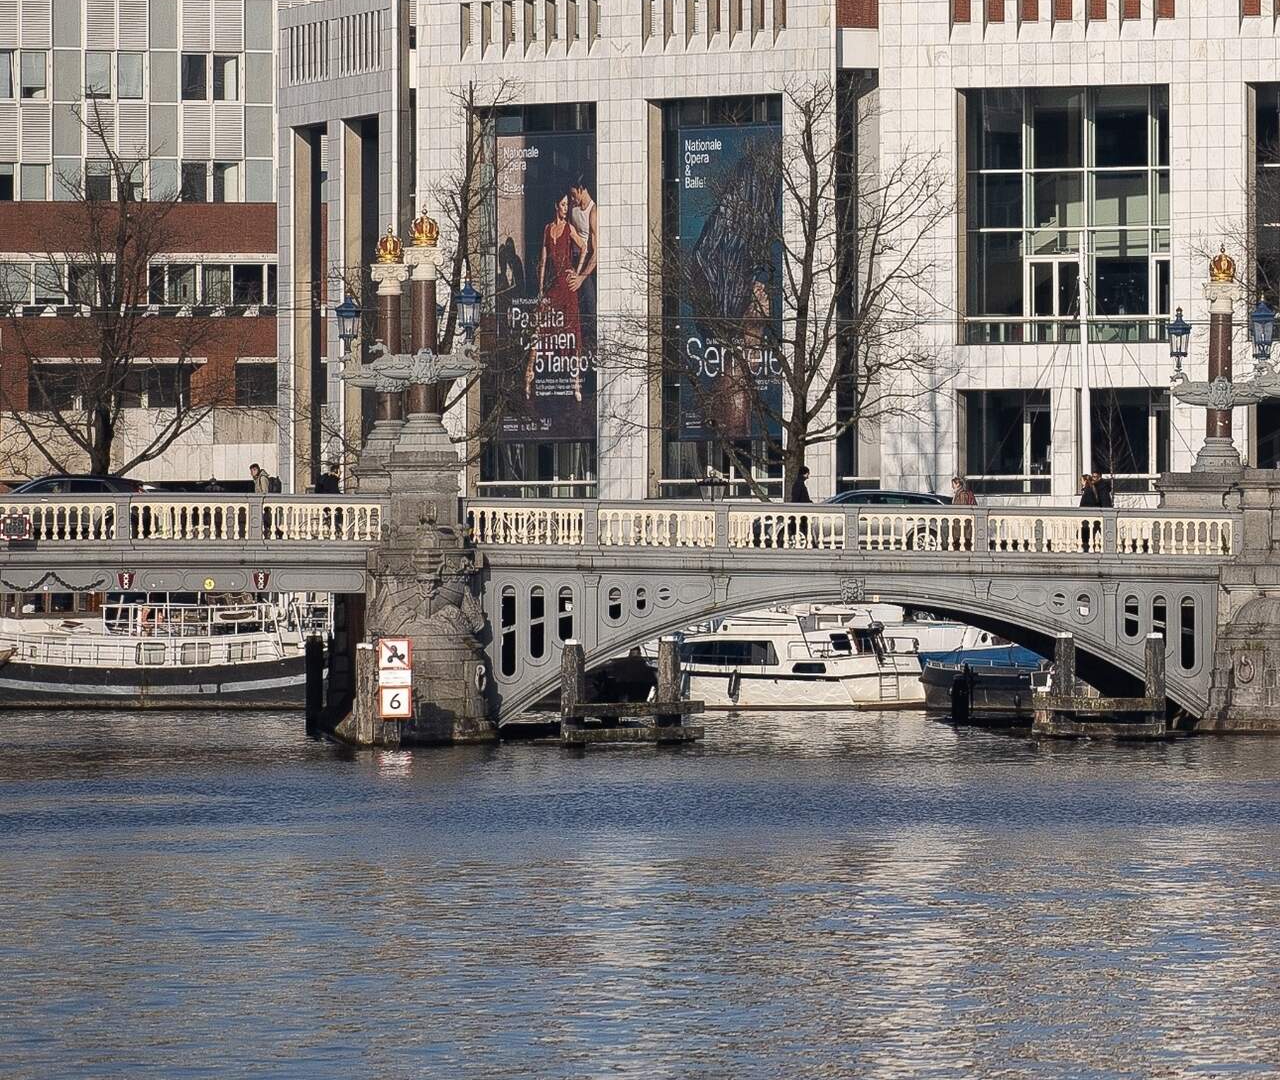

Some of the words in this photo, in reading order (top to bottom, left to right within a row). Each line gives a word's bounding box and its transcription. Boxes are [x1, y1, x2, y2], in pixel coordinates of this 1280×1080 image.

[503, 145, 539, 159] Nationale
[685, 138, 722, 152] Nationale
[684, 151, 709, 166] Opera
[684, 164, 691, 176] &
[685, 176, 706, 189] Ballet
[390, 693, 401, 710] 6
